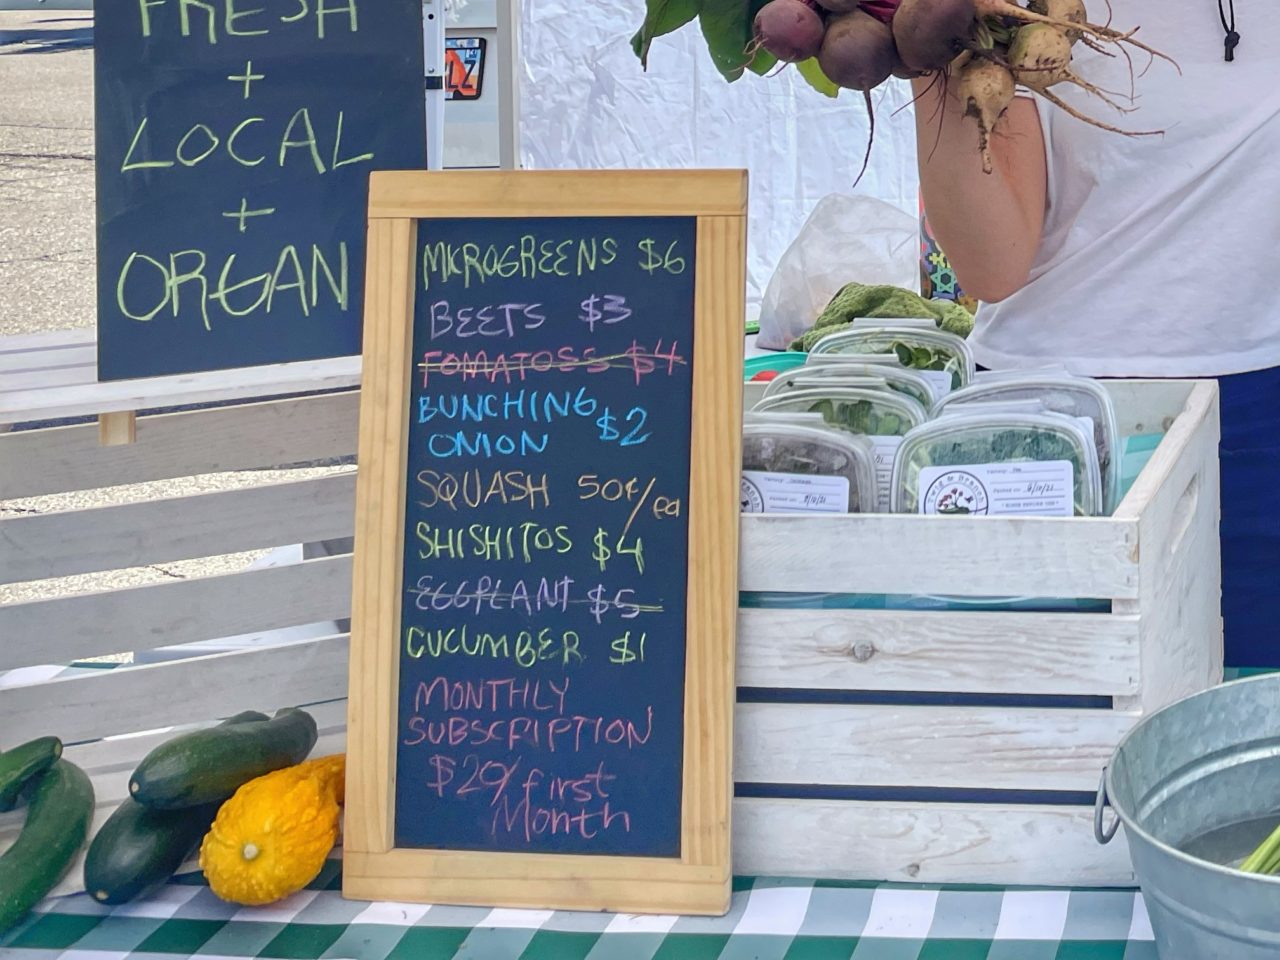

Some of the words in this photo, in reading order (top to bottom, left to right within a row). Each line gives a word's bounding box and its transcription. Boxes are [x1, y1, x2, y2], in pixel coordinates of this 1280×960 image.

[120, 108, 374, 174] LOCAL
[638, 238, 685, 275] $6
[116, 242, 348, 331] ORGAN
[430, 300, 547, 340] BEETS
[579, 294, 632, 332] $3
[625, 339, 682, 386] $4
[418, 386, 597, 424] BUNCHING
[596, 406, 653, 447] $2
[428, 430, 549, 458] ONION
[417, 468, 550, 511] SQUASH
[416, 521, 572, 563] SHISHITOS
[592, 527, 645, 576] $4
[415, 575, 574, 616] EGGPLANT
[587, 583, 640, 625] $5
[407, 625, 583, 667] CUCUMBER
[609, 631, 646, 665] $1
[415, 676, 570, 715] MONTHLY
[404, 706, 653, 752] SUBSCRIPTION
[491, 795, 630, 841] Month
